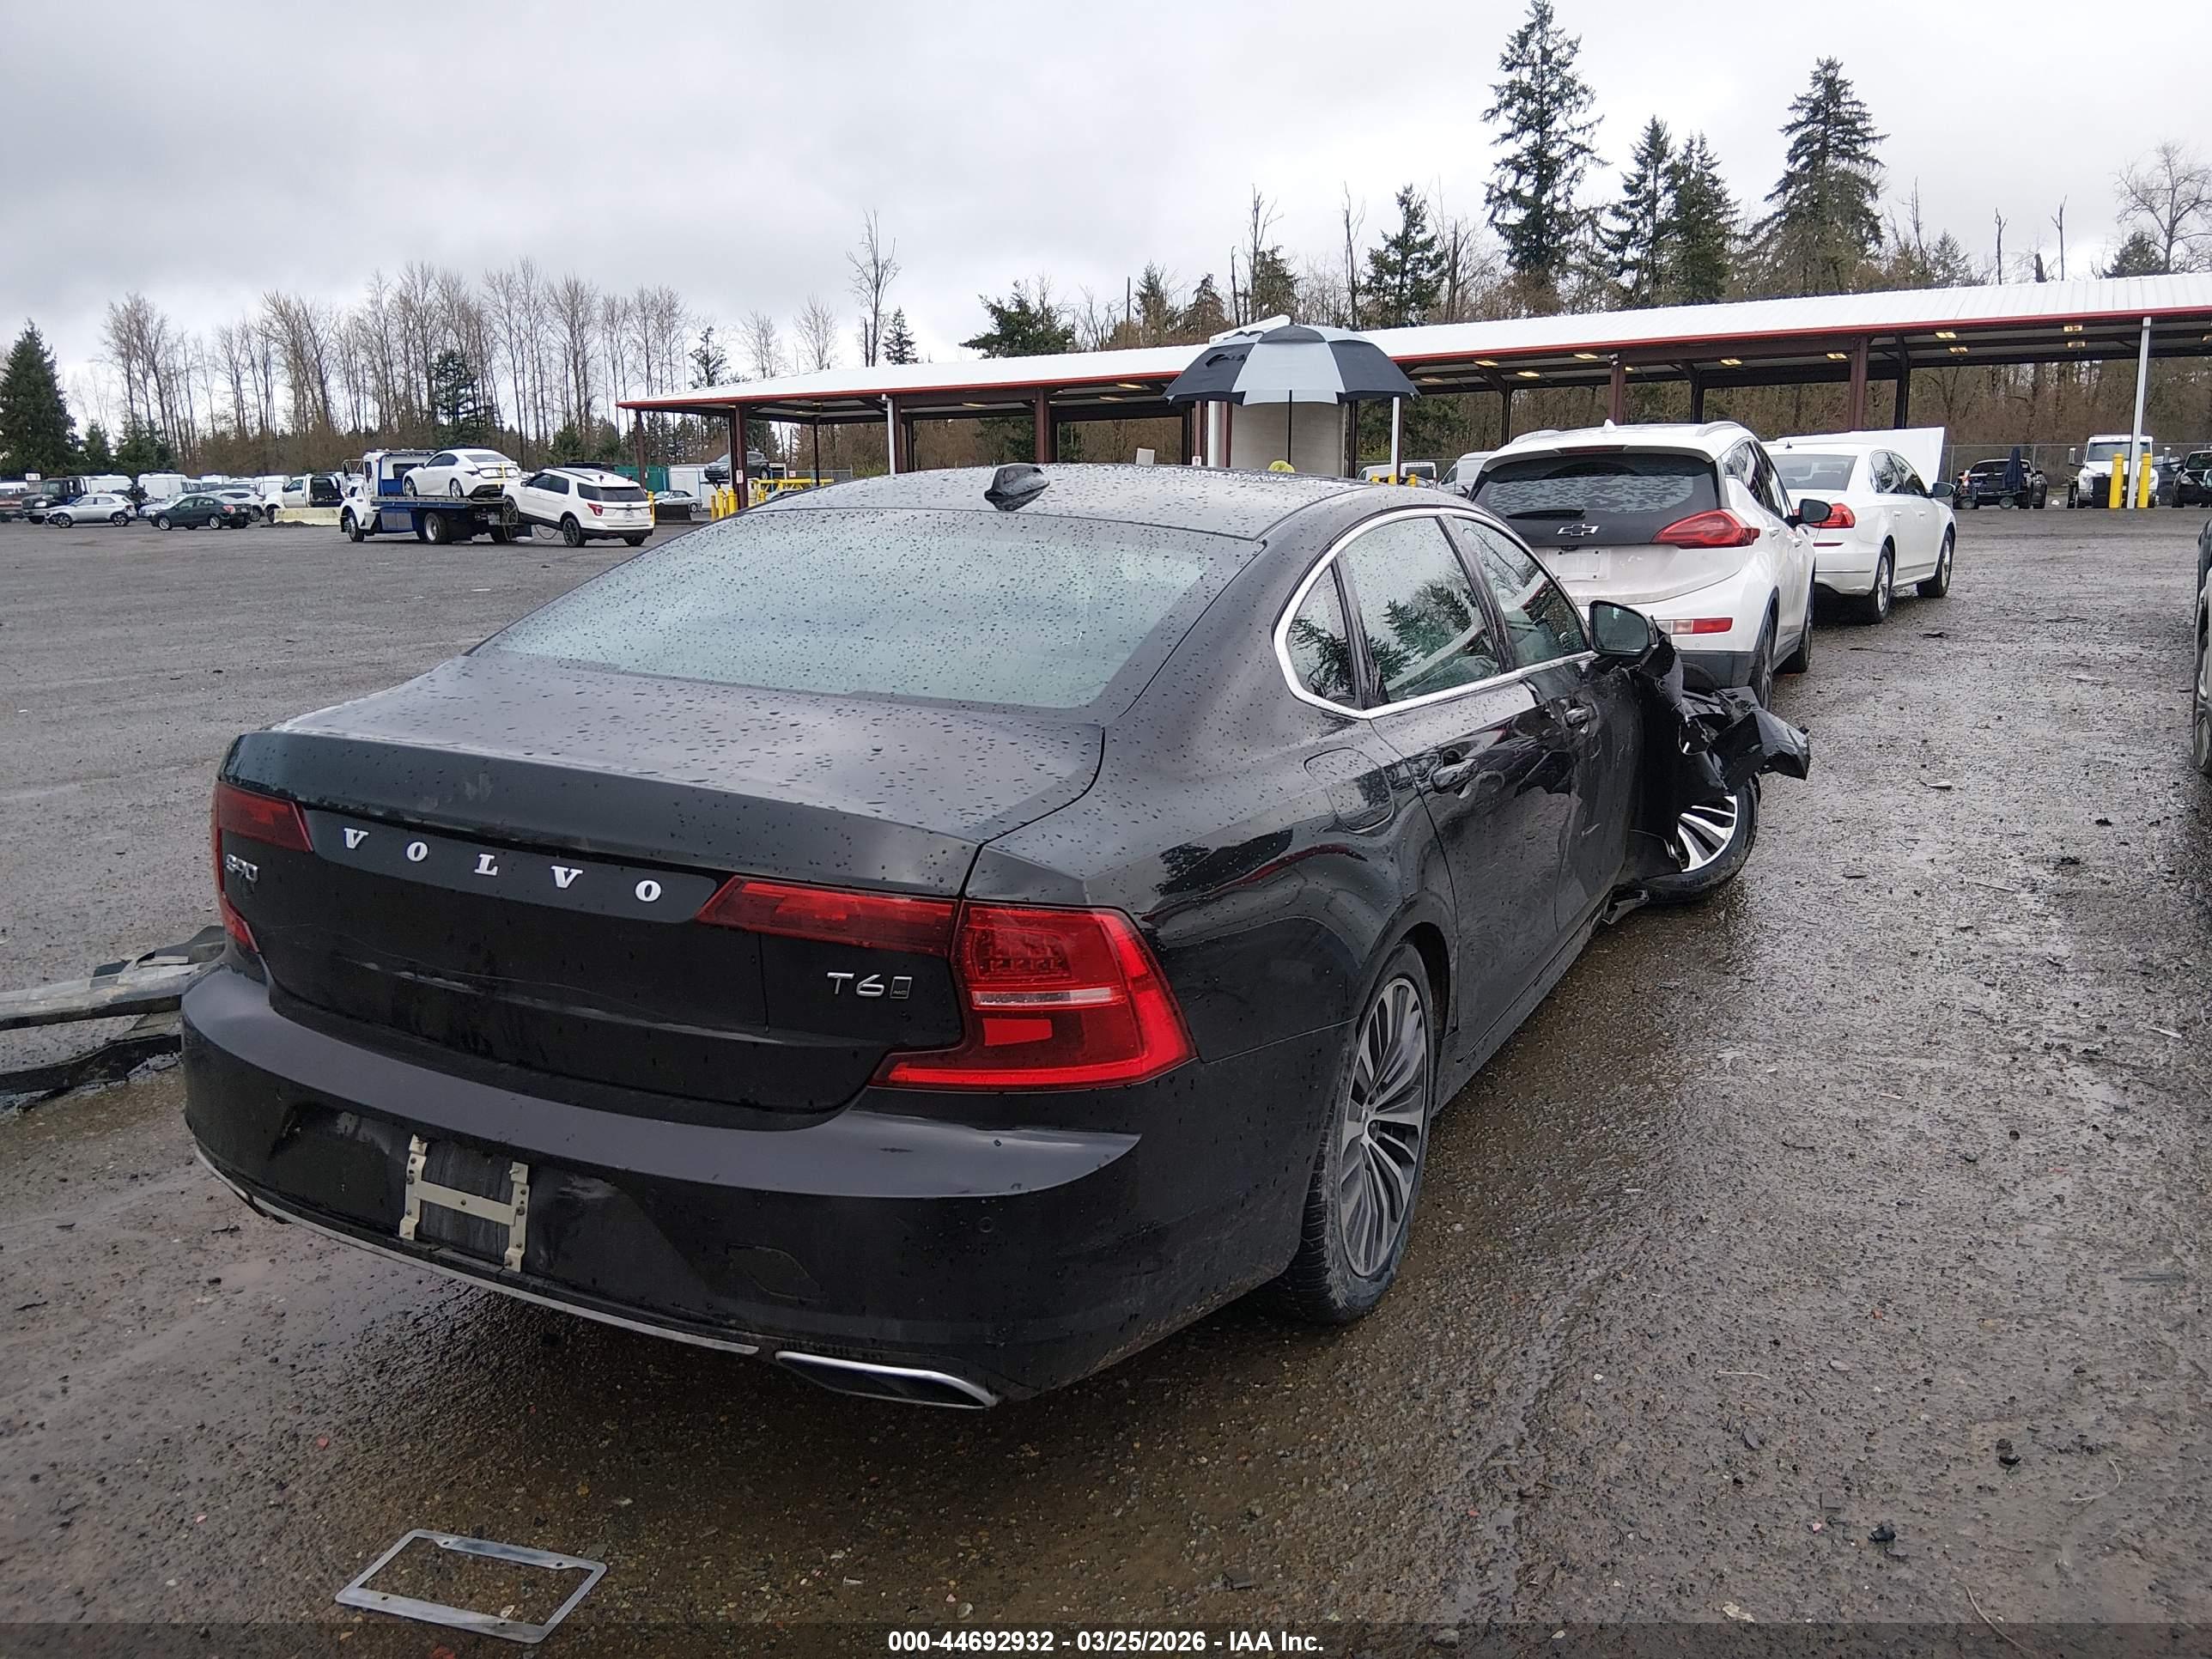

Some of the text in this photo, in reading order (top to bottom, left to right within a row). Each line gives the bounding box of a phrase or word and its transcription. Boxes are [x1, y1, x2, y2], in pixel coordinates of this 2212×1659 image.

[226, 854, 258, 884] S90
[343, 828, 661, 902] VOLVO
[827, 971, 885, 997] T6
